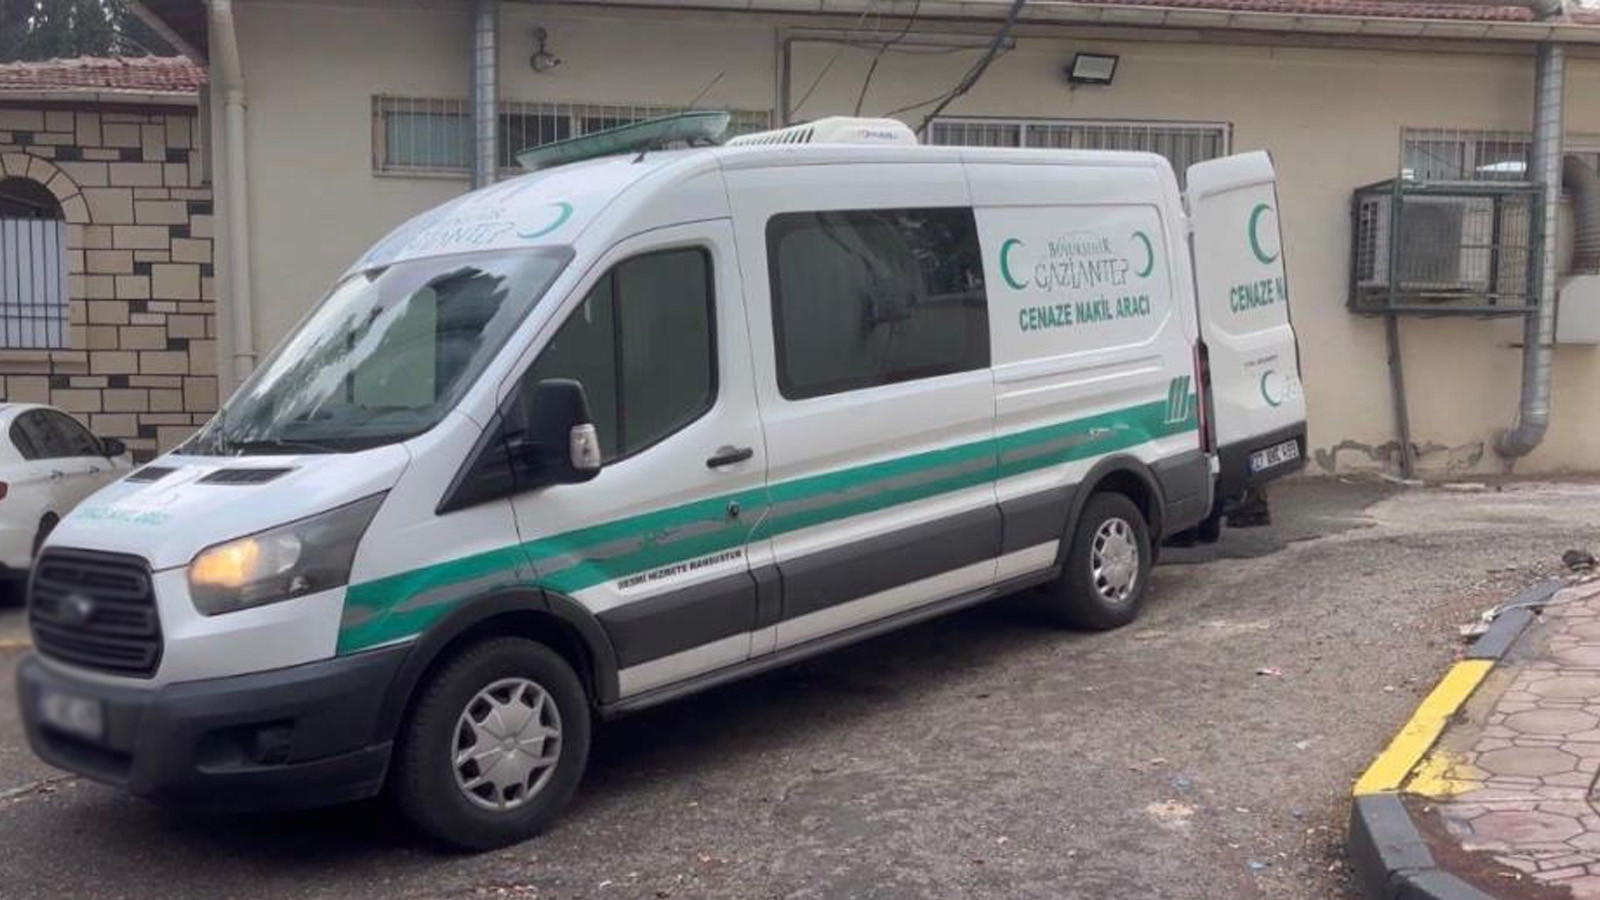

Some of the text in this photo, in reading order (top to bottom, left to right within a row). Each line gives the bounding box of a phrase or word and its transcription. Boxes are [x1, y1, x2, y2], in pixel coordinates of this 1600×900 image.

[1019, 294, 1151, 331] CENAZE NAKİL ARACI
[1230, 279, 1273, 314] CENAZE
